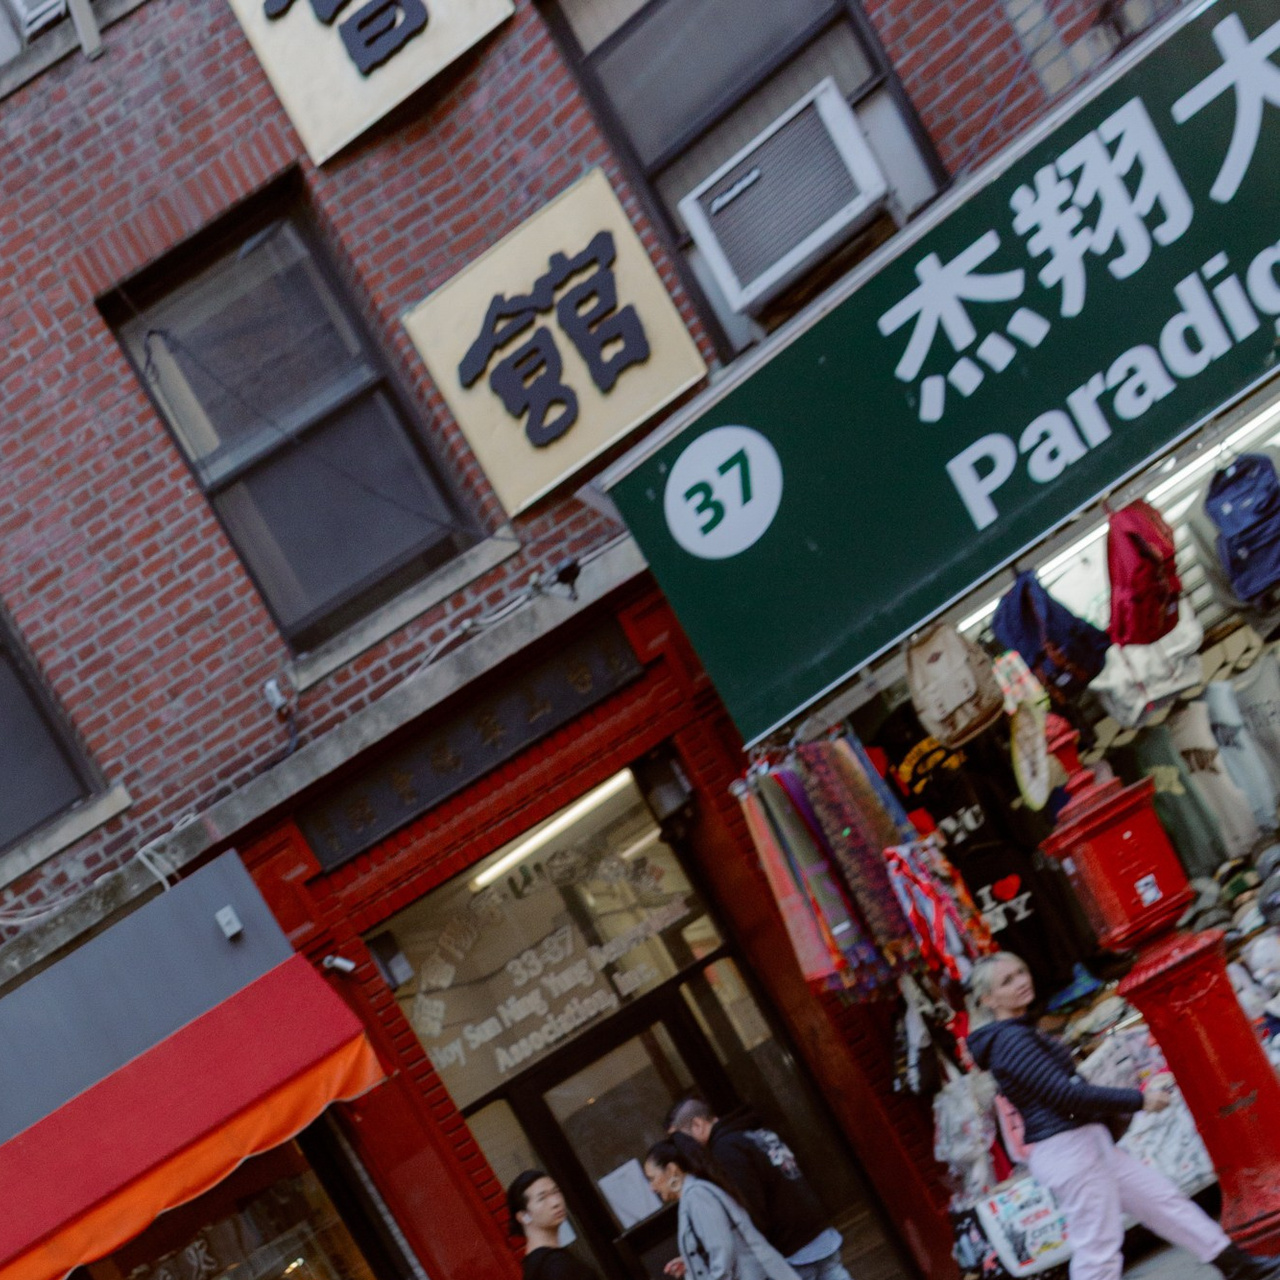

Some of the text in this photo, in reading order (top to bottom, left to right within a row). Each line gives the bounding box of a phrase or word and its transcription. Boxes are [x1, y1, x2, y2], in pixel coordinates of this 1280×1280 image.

[459, 231, 650, 447] 館
[684, 448, 756, 537] 37
[980, 891, 1035, 935] NY
[493, 989, 619, 1074] Association,
